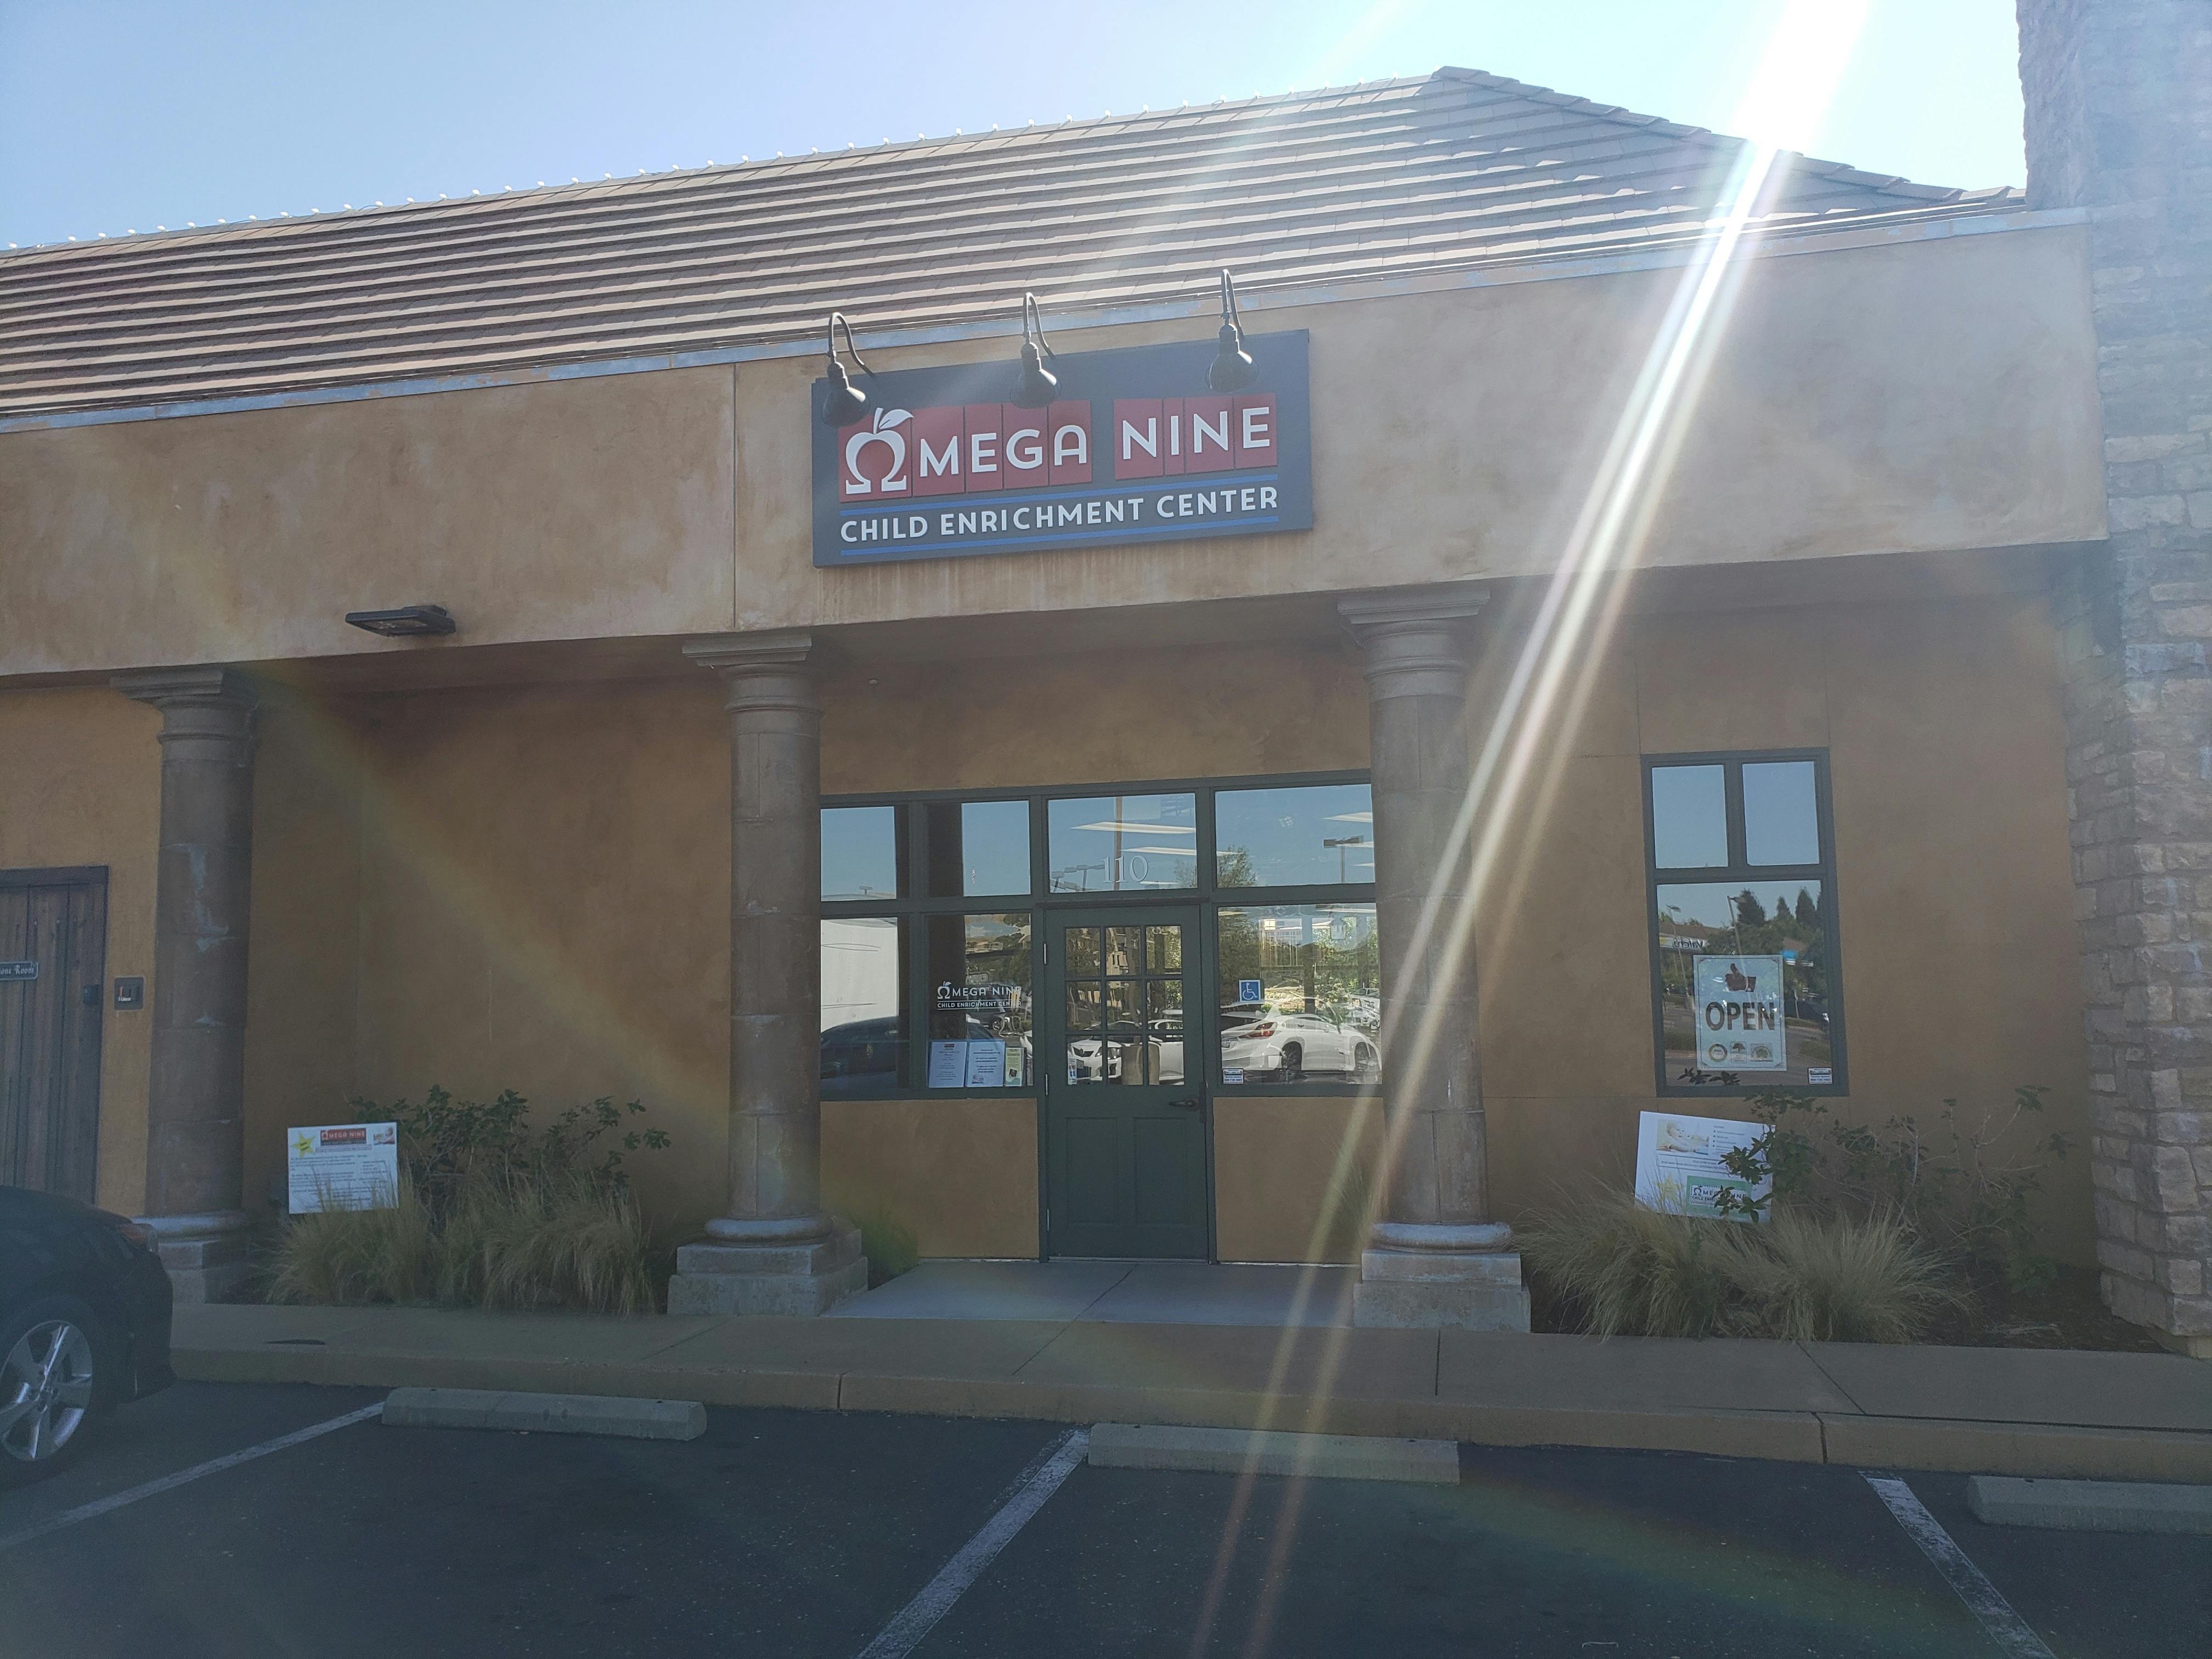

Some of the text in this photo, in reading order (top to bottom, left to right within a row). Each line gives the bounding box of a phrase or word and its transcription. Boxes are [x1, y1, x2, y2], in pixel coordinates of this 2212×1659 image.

[1122, 407, 1270, 460] NINE
[841, 487, 1278, 543] CHILD ENRICHMENT CENTER
[1102, 855, 1148, 883] 110
[1706, 1002, 1775, 1031] OPEN
